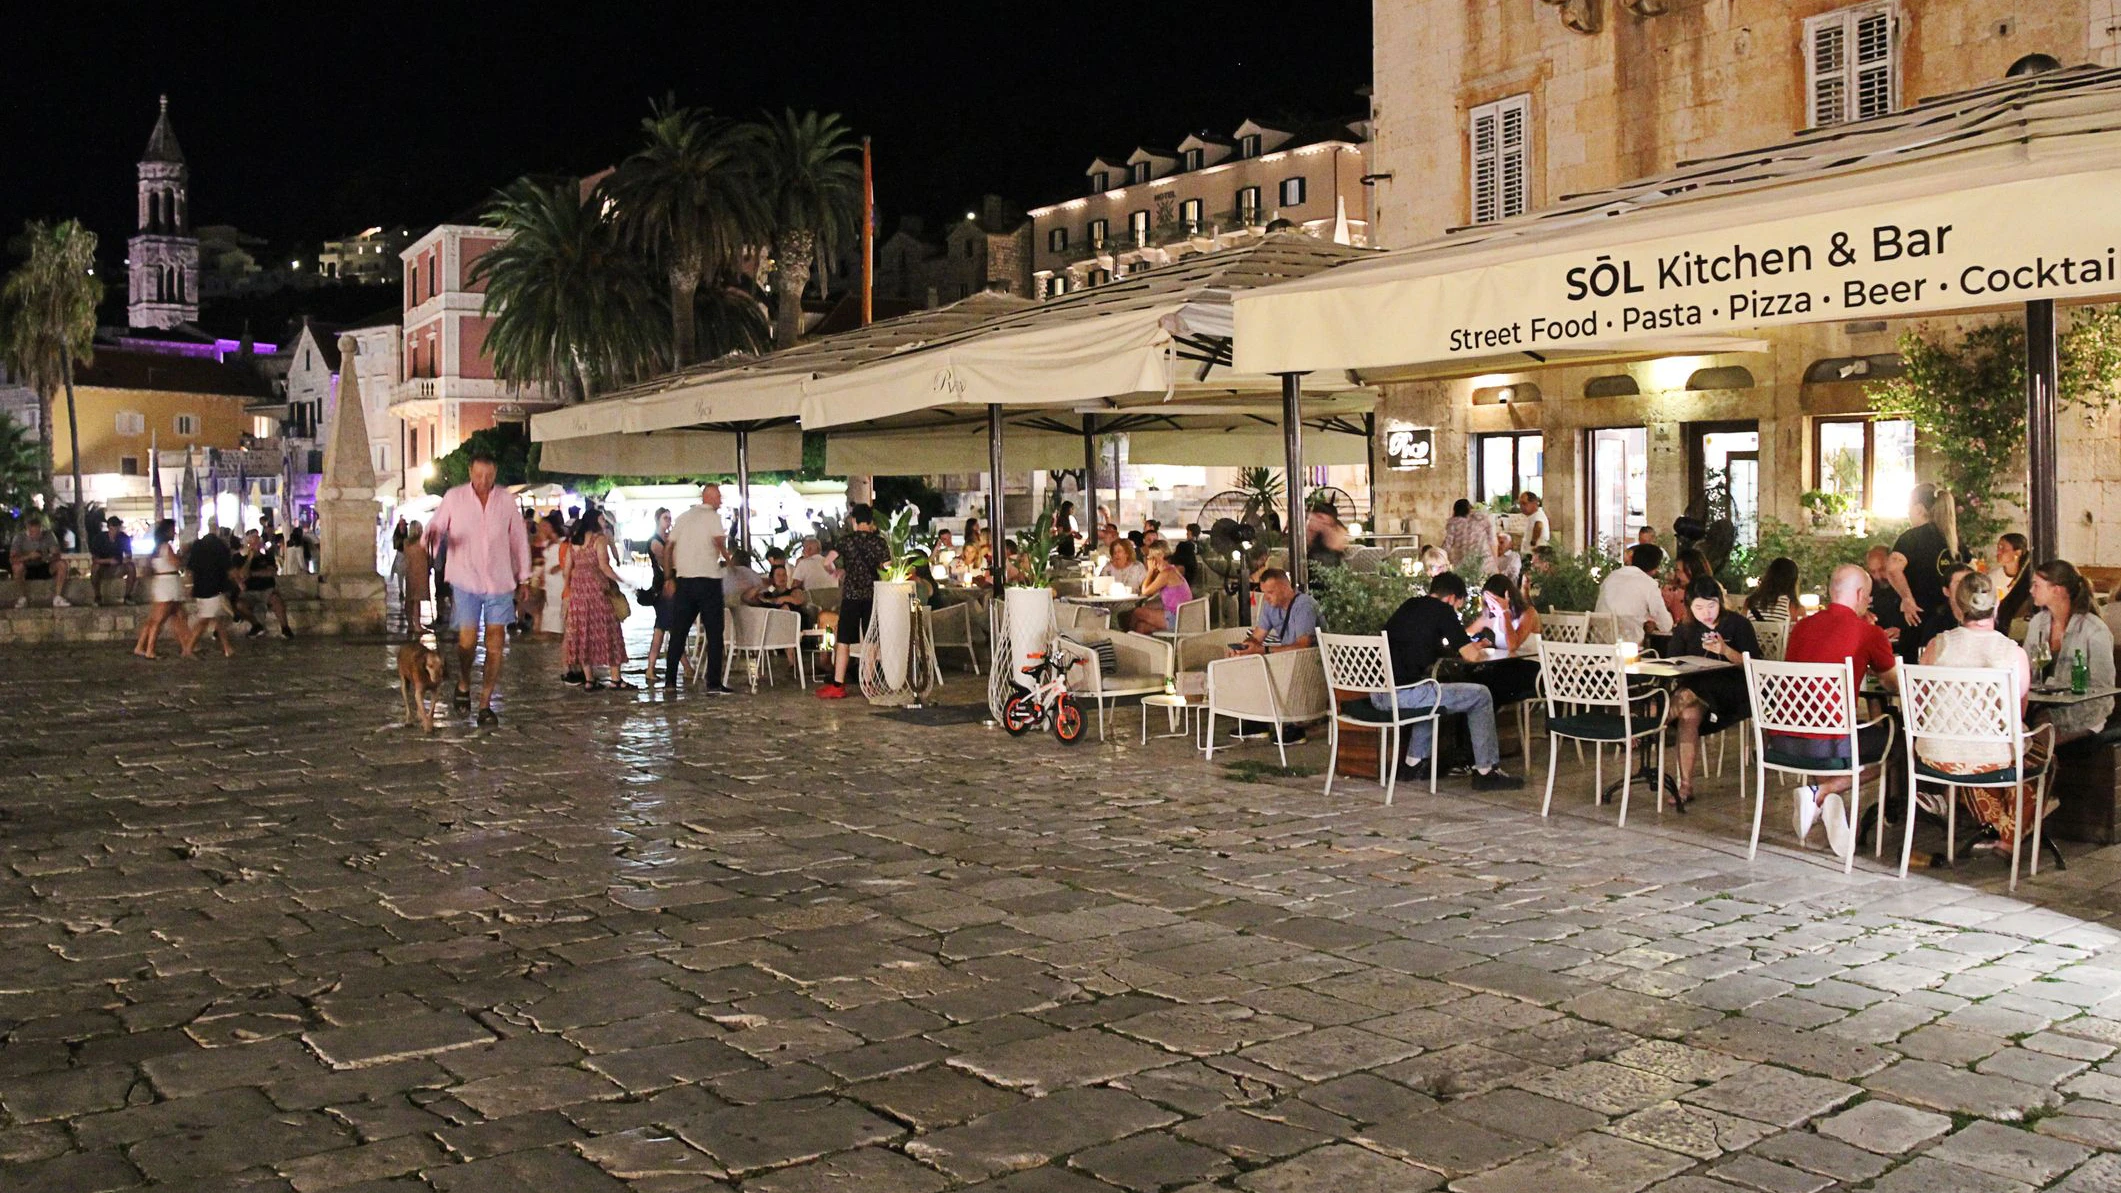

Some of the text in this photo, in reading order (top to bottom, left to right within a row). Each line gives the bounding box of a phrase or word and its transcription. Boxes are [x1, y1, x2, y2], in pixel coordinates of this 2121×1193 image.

[1658, 244, 1812, 290] Kitchen
[1827, 231, 1857, 268] &
[1873, 224, 1953, 262] Bar
[1449, 322, 1522, 352] Street
[1531, 310, 1598, 342] Food
[1623, 303, 1702, 333] Pasta
[1729, 289, 1812, 321] Pizza
[1844, 278, 1927, 308] Beer
